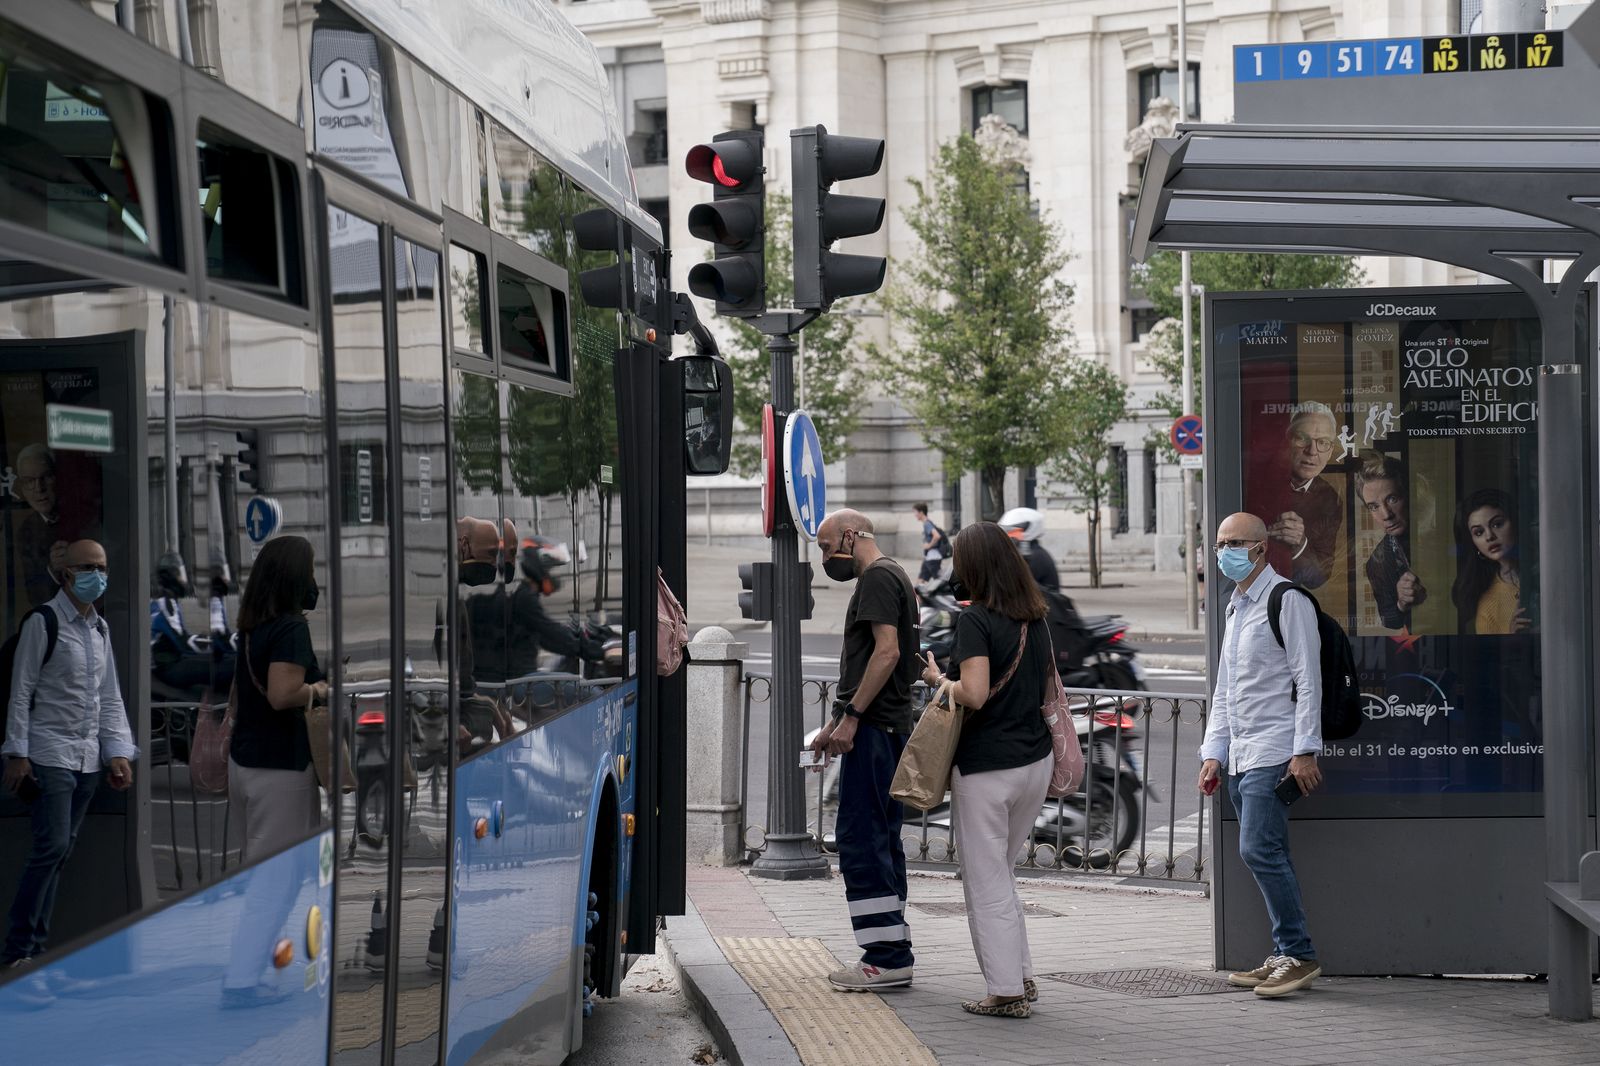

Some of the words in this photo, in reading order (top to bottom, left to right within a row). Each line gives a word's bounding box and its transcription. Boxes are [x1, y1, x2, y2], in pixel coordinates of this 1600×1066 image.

[1253, 51, 1262, 76] 1
[1297, 50, 1312, 74] 9
[1337, 47, 1363, 72] 51
[1384, 45, 1414, 70] 74
[1433, 50, 1459, 72] N5
[1480, 48, 1507, 70] N6
[1526, 46, 1553, 67] N7
[1366, 304, 1437, 316] JCDecaux
[1306, 328, 1335, 336] MARTIN
[1246, 336, 1288, 345] MARTIN
[1303, 335, 1339, 344] SHORT
[1356, 334, 1395, 343] GOMEZ
[1462, 338, 1489, 347] Original
[1404, 347, 1469, 368] SOLO
[1404, 367, 1533, 388] ASESINATOS
[1461, 389, 1479, 402] EN
[1485, 389, 1501, 401] EL
[1461, 402, 1539, 423] EDIFICI
[1407, 428, 1438, 436] TODOS
[1438, 427, 1472, 436] TIENEN
[1472, 427, 1486, 435] UN
[1486, 426, 1526, 435] SECRETO
[1349, 745, 1362, 756] el
[1366, 744, 1382, 756] 31
[1388, 744, 1406, 755] de
[1410, 744, 1457, 758] agosto
[1462, 746, 1479, 755] en
[1483, 742, 1544, 755] exclusiva
